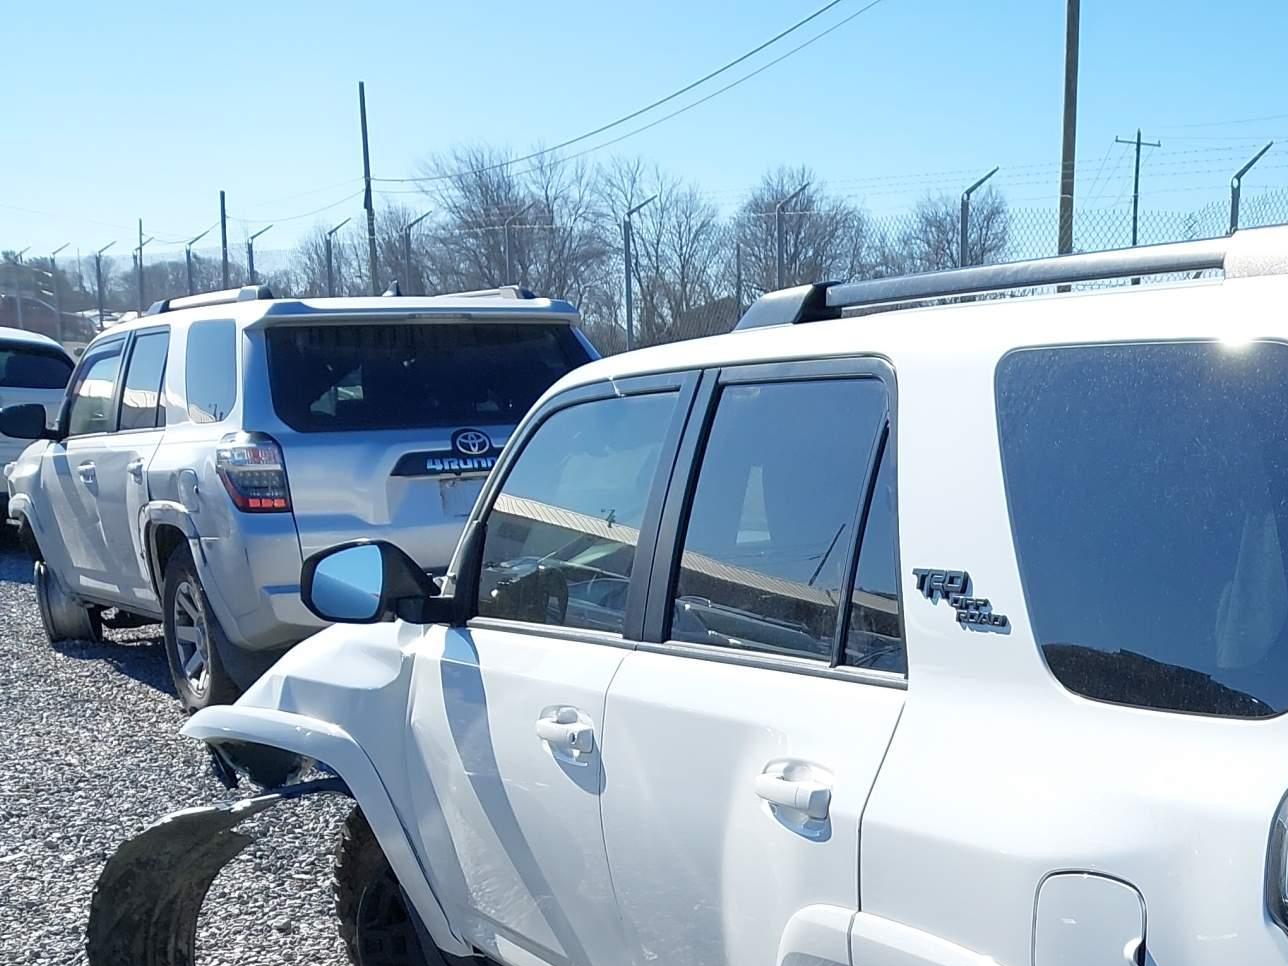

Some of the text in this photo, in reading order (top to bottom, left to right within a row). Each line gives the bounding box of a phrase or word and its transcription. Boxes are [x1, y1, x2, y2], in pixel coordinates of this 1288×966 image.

[912, 568, 973, 606] TRD
[949, 596, 993, 613] OFF
[956, 609, 1012, 635] ROAD
